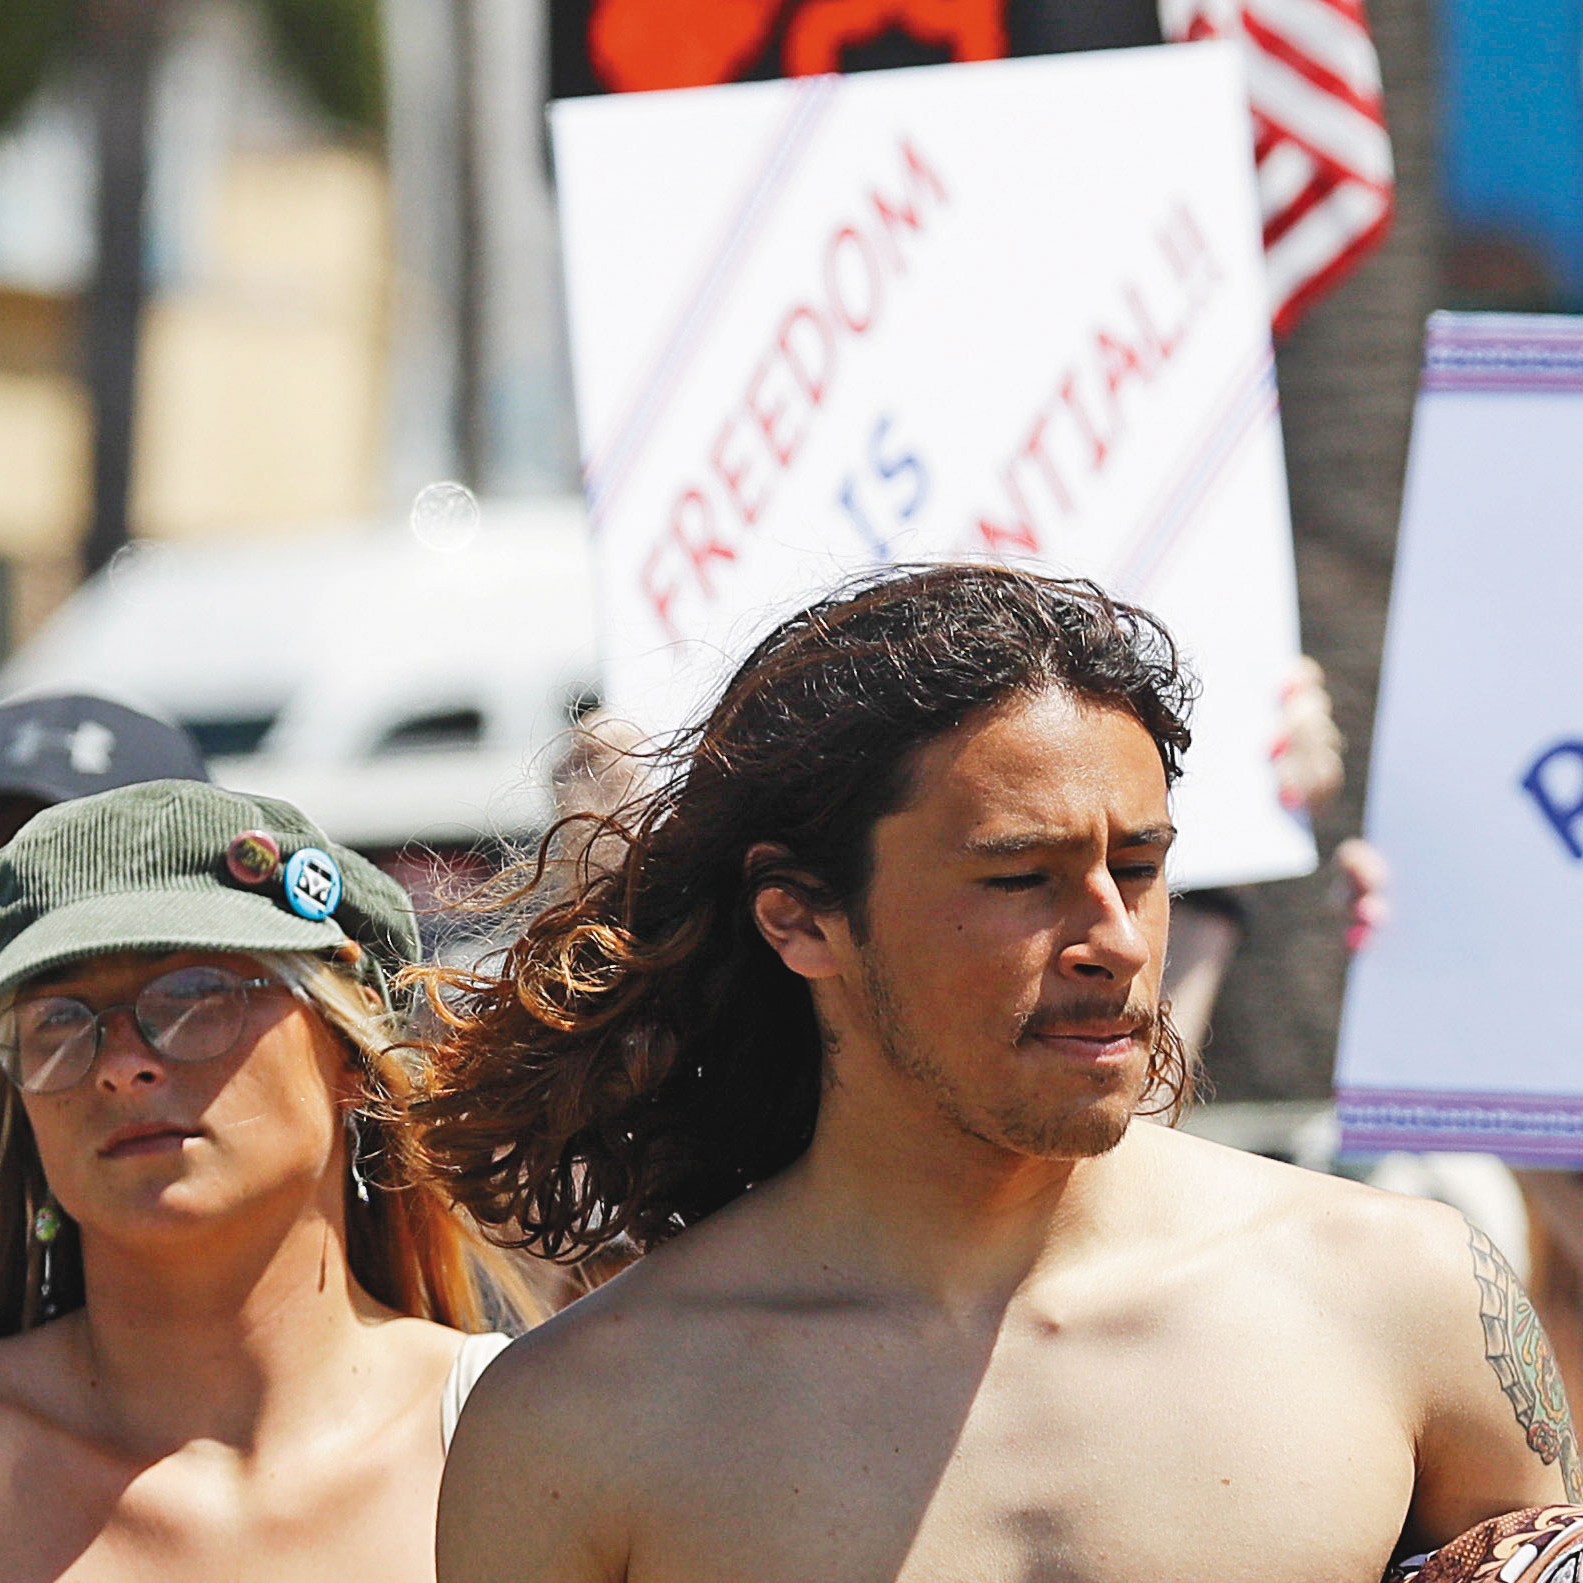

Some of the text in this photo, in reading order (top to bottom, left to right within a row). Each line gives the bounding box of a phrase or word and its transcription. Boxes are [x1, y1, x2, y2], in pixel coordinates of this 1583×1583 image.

[635, 132, 955, 654] FREEDOM
[835, 408, 932, 565] IS
[962, 197, 1226, 558] NTIAL!!
